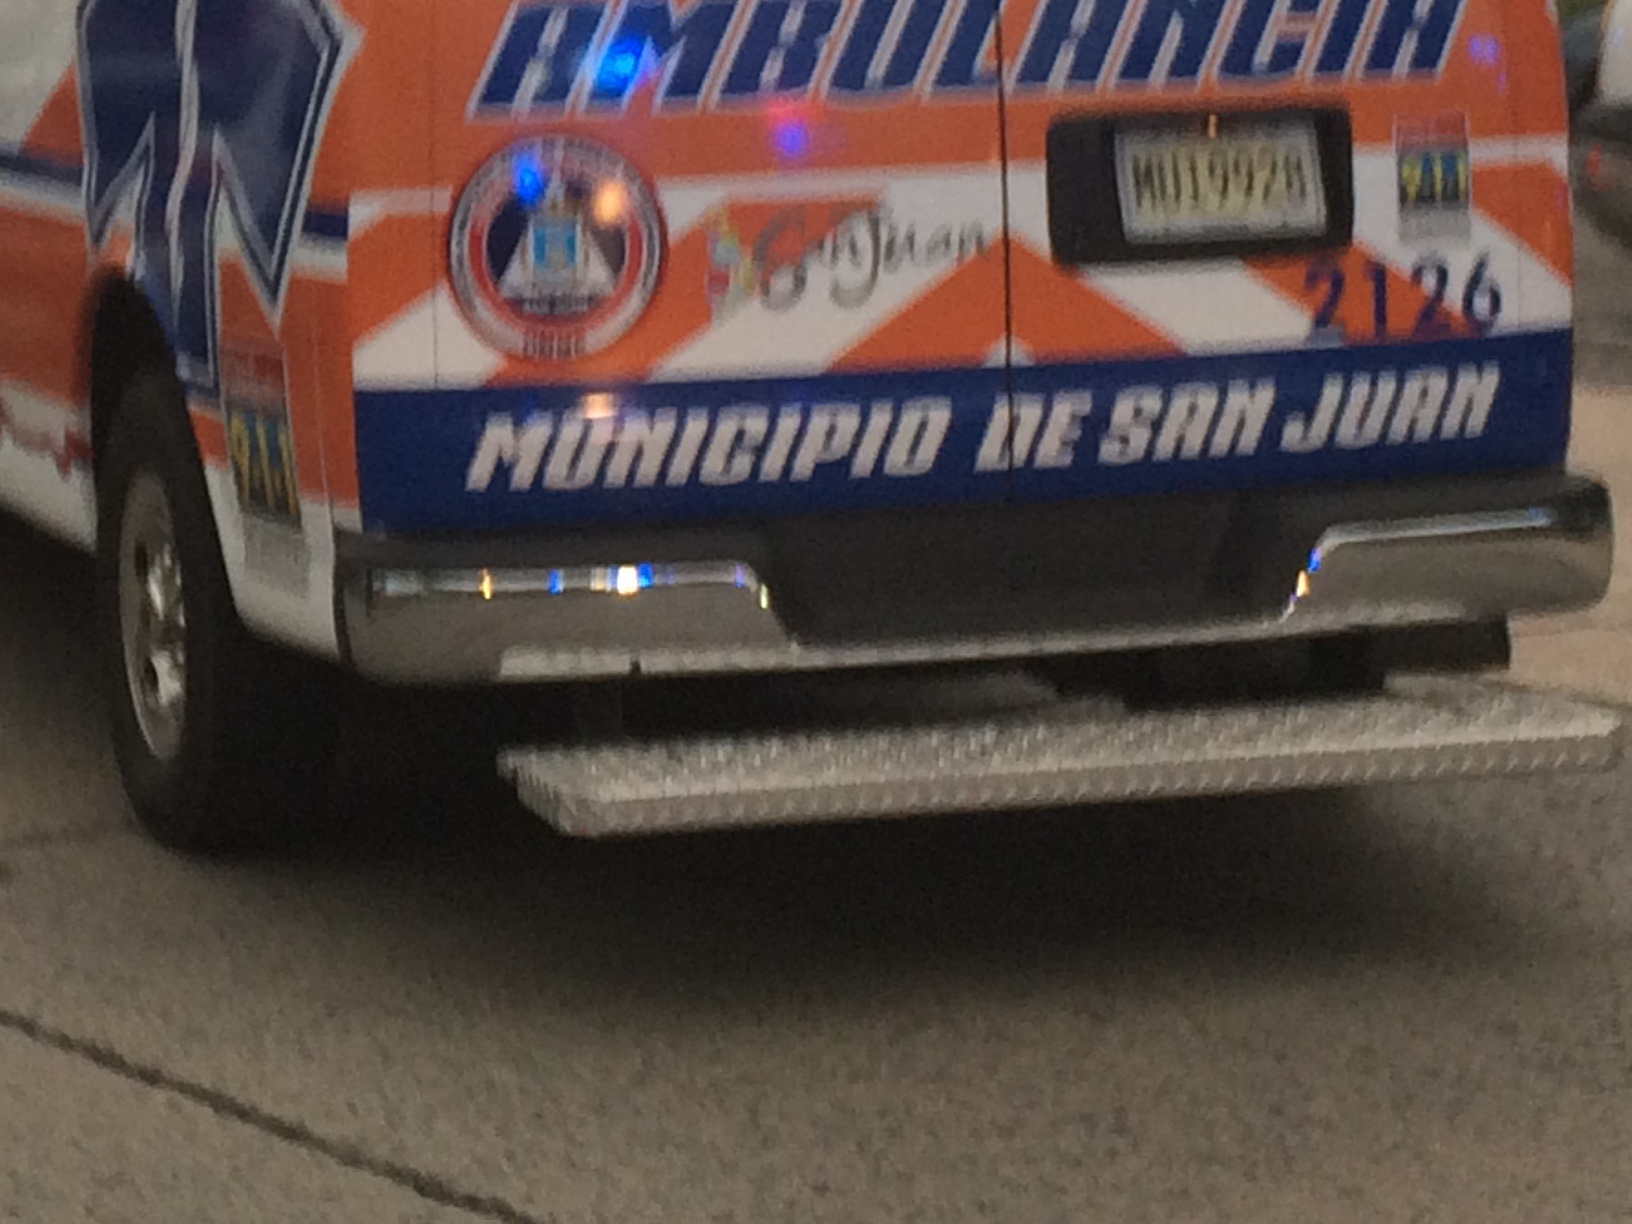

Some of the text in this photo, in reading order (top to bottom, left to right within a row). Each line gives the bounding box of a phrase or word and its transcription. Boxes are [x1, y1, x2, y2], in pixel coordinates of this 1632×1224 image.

[1304, 252, 1503, 348] 2126
[465, 360, 1501, 492] MUNICIPIO DE SAN JUAN
